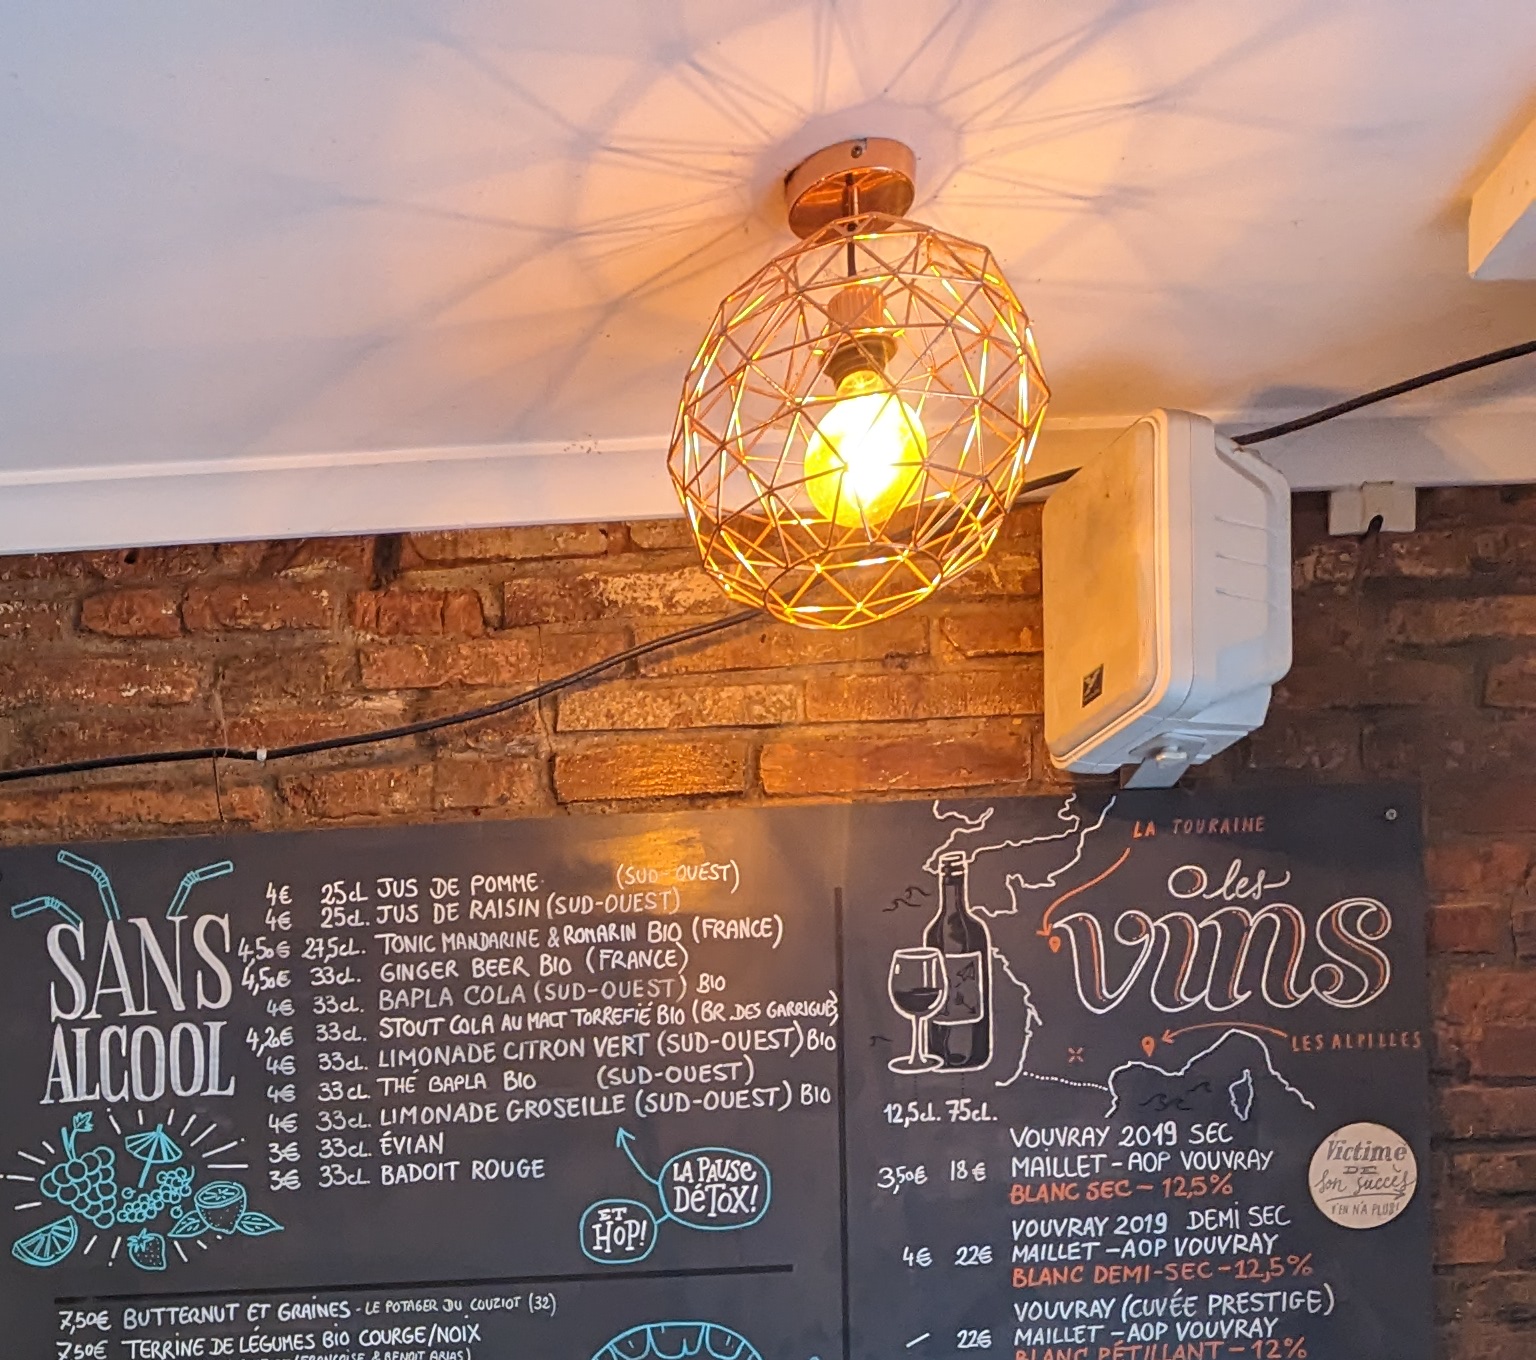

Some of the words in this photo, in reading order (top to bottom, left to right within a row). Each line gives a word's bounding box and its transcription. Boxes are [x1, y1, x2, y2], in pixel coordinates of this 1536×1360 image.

[1132, 821, 1155, 841] LA
[1172, 816, 1266, 835] TOURAINE
[266, 882, 292, 906] 4€
[377, 878, 418, 898] JUS
[430, 878, 460, 899] DE
[471, 873, 538, 895] POMME
[374, 933, 436, 955] TONIC
[442, 929, 540, 953] MANDARINE
[693, 914, 782, 948] (FRANCE)
[45, 912, 233, 1023] SANS
[380, 960, 459, 982] GINGER
[472, 956, 530, 978] BEER
[1052, 896, 1393, 1015] vins
[40, 1021, 235, 1104] ALCOOL
[379, 1131, 443, 1155] ÉVIAN
[1010, 1126, 1110, 1151] VOUVRAY
[1118, 1121, 1177, 1147] 2019
[1189, 1122, 1233, 1144] SEC
[381, 1161, 460, 1185] BADOIT
[472, 1159, 545, 1180] ROUGE
[673, 1161, 694, 1183] LA
[1010, 1183, 1079, 1204] BLANC
[1163, 1173, 1232, 1198] 12,5%
[124, 1303, 240, 1329] BUTTERNUT
